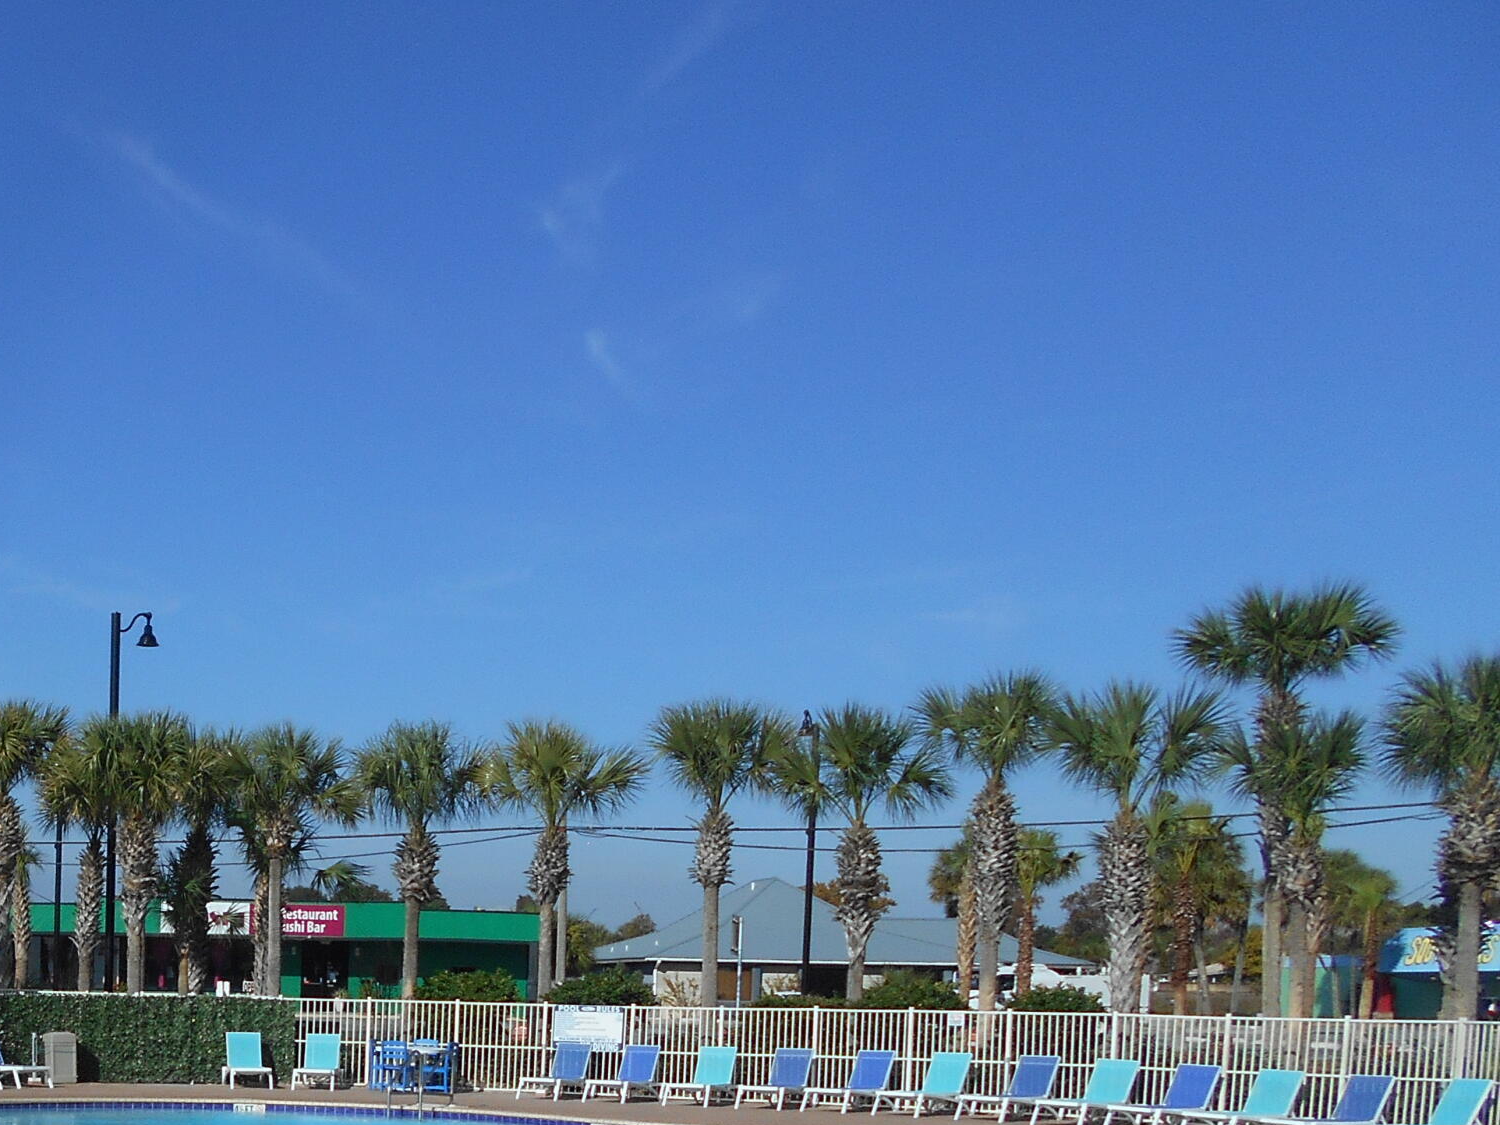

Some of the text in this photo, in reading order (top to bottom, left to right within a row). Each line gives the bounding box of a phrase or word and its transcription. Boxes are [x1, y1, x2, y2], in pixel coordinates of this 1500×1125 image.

[283, 920, 326, 933] ushi Bar
[558, 1005, 620, 1014] POOL RULES
[593, 1043, 619, 1052] DIVING
